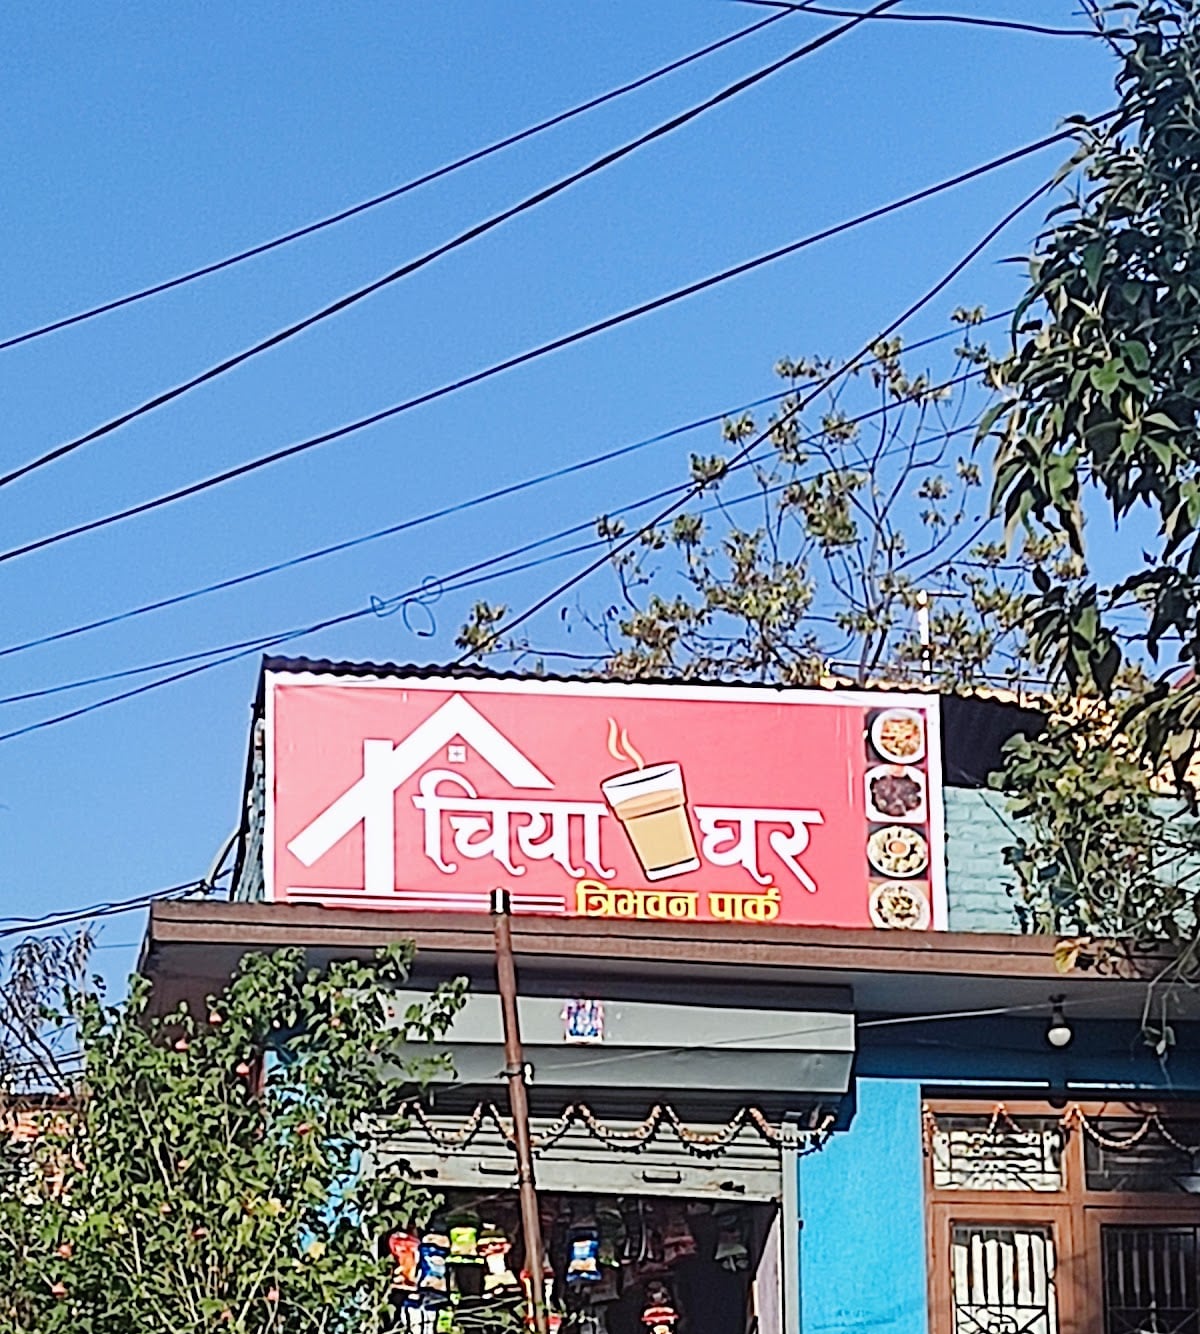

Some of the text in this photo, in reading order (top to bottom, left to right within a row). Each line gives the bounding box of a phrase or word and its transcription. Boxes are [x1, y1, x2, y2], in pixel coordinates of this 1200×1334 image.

[411, 768, 825, 894] चिया घर
[708, 887, 781, 921] पार्क
